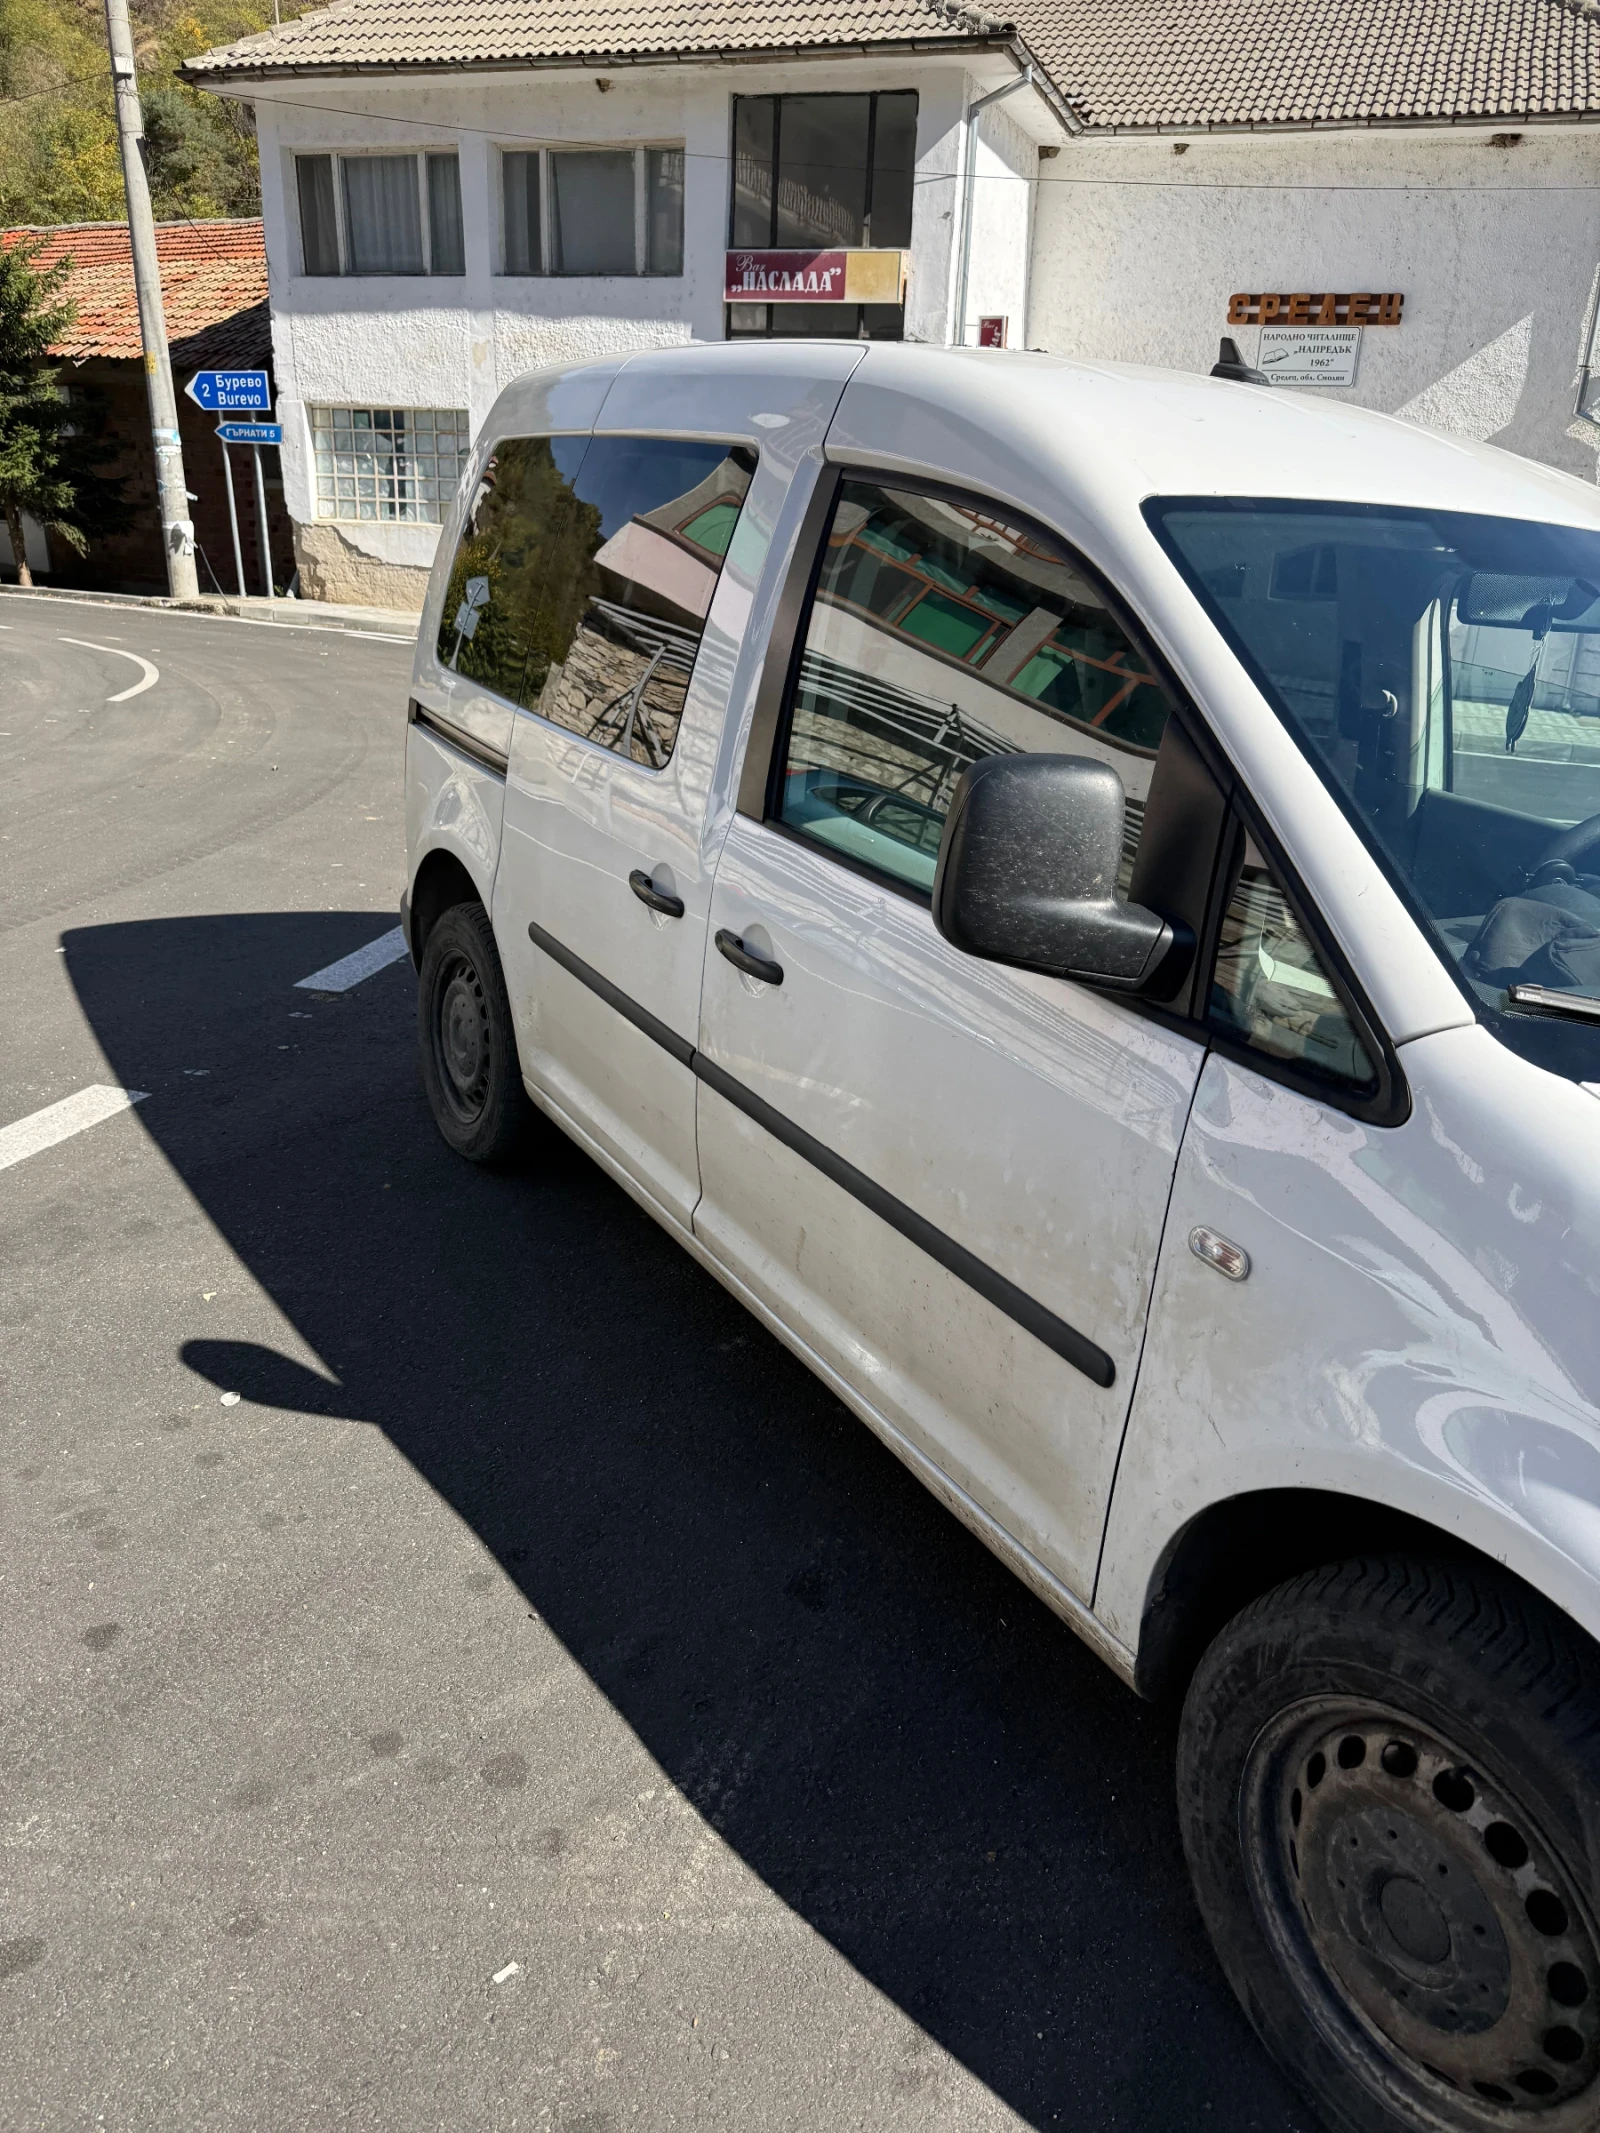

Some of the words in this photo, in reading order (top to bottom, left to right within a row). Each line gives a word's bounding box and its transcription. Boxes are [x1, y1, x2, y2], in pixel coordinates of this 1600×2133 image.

[1227, 293, 1404, 325] СРЕДЕЦ
[1263, 333, 1306, 342] НАРОДНО
[1307, 333, 1357, 342] ЧИТАЛИЩЕ
[215, 374, 262, 391] Бурево
[202, 384, 211, 397] 2
[217, 391, 261, 405] Burevo
[225, 428, 267, 438] ГЪРНАТИ
[269, 429, 276, 438] 5
